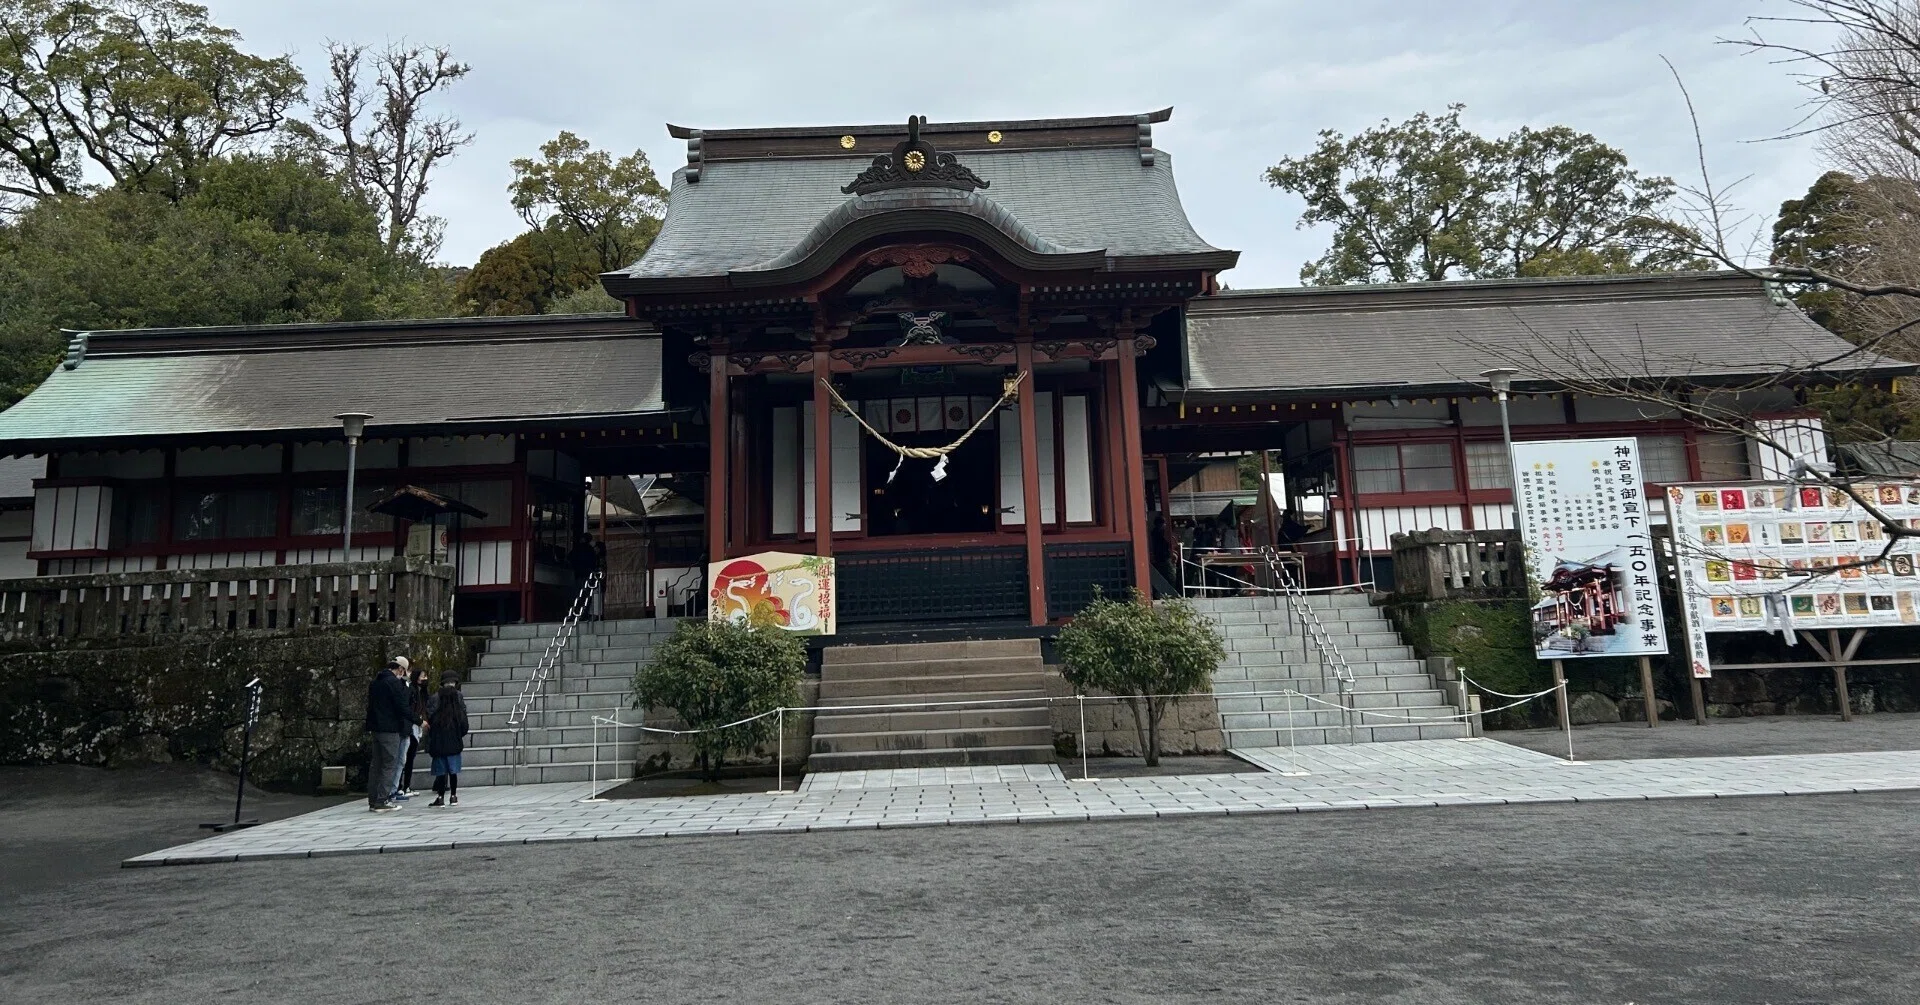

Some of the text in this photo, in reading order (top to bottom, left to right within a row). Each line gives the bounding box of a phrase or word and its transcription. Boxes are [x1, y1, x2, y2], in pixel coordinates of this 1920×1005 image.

[1602, 460, 1620, 530] 奉祝記念事業内容
[1614, 445, 1658, 647] 神宮号御宣下一五〇年記念事業
[818, 563, 831, 620] 開運招福
